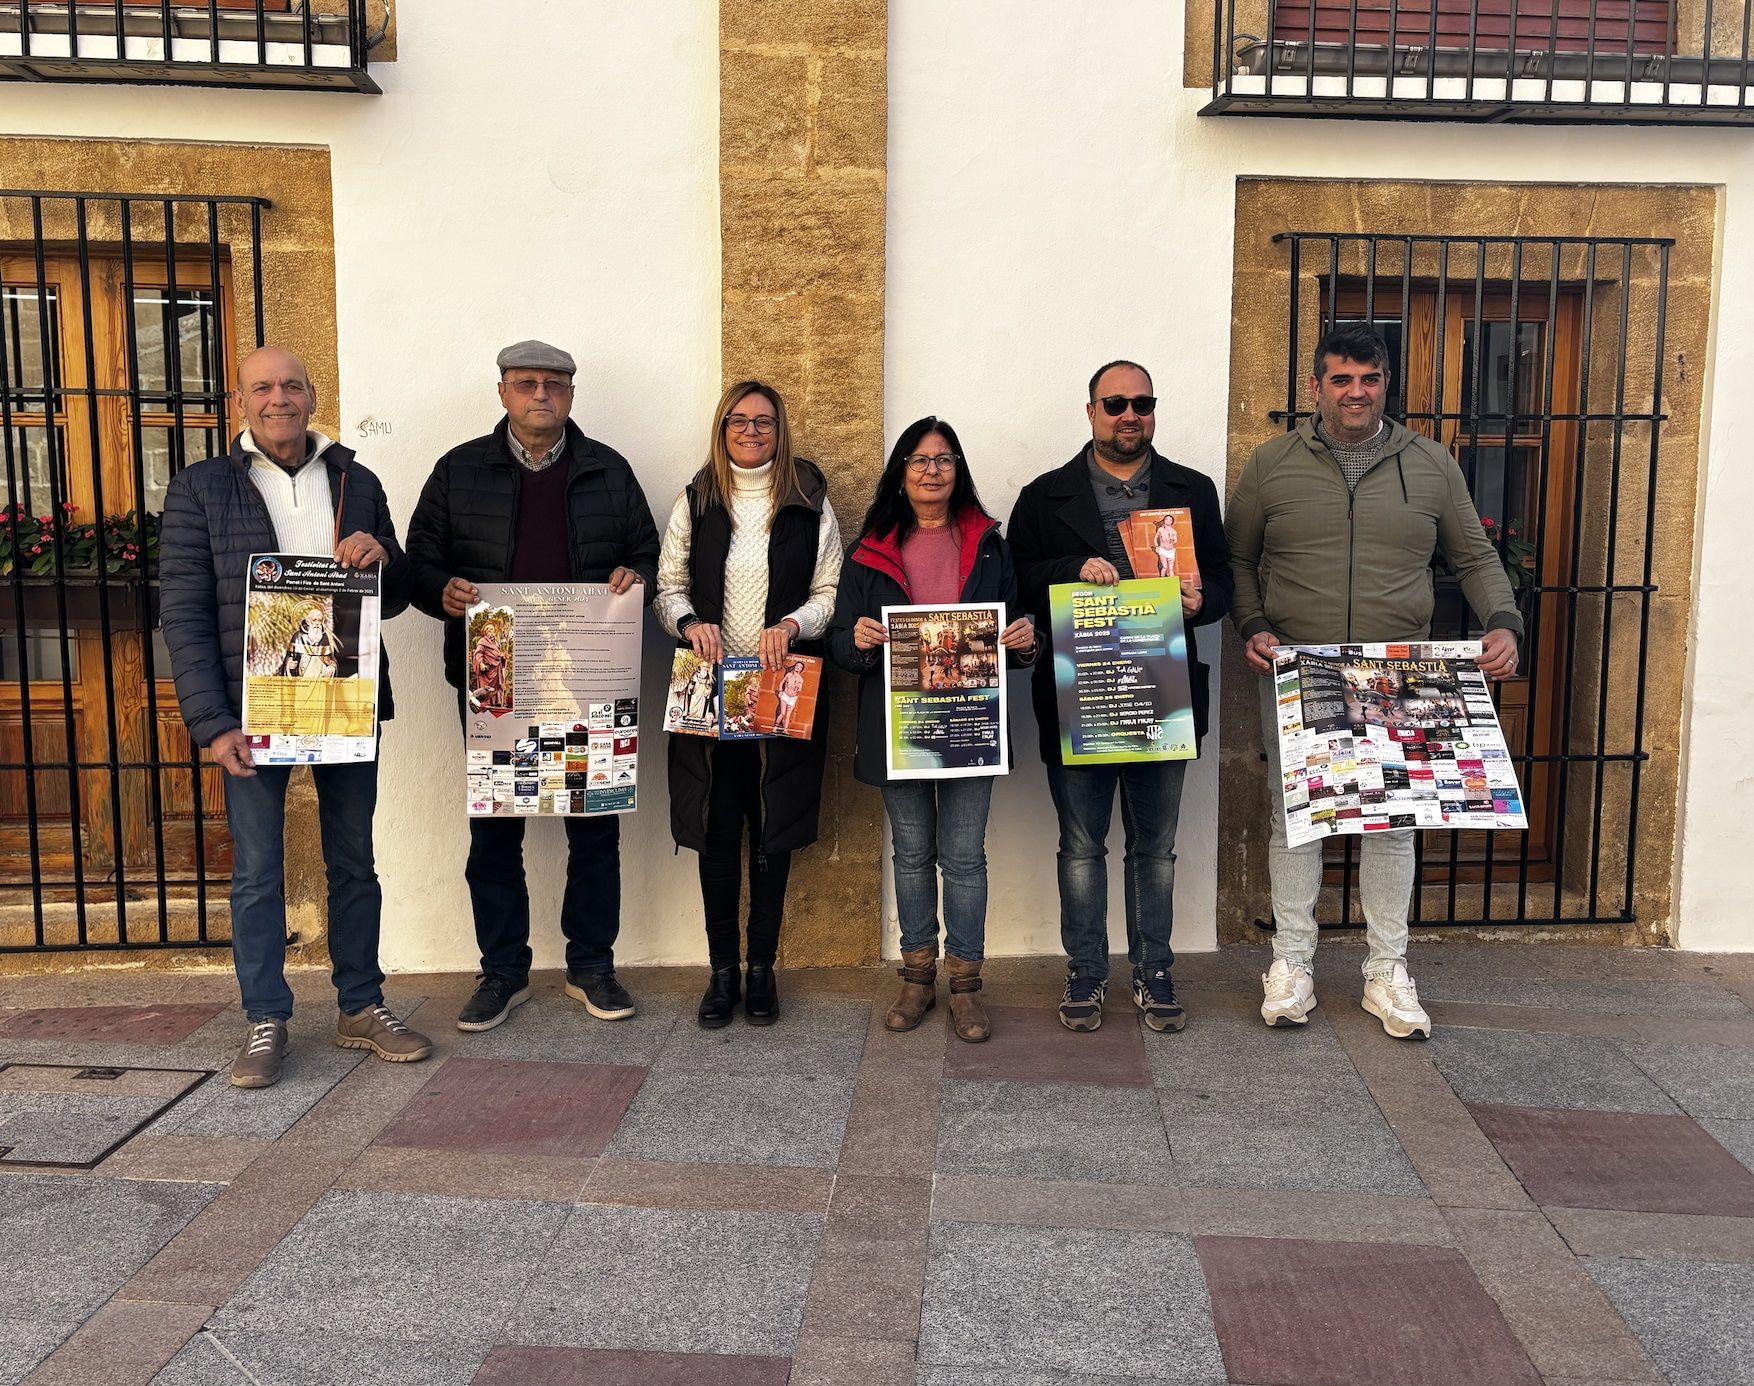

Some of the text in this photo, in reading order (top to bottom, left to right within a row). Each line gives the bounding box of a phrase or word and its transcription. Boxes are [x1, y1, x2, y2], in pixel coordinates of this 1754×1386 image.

[359, 419, 392, 438] SAMU
[284, 569, 301, 577] Sant
[501, 587, 609, 595] SANT ANTONI ABAT
[1072, 595, 1118, 608] SANT
[1072, 602, 1156, 618] SEBASTIÀ
[928, 612, 950, 622] SANT
[1074, 617, 1116, 629] FEST
[1353, 658, 1384, 670] SANT
[920, 695, 966, 704] SEBASTIÀ
[967, 694, 991, 702] FEST
